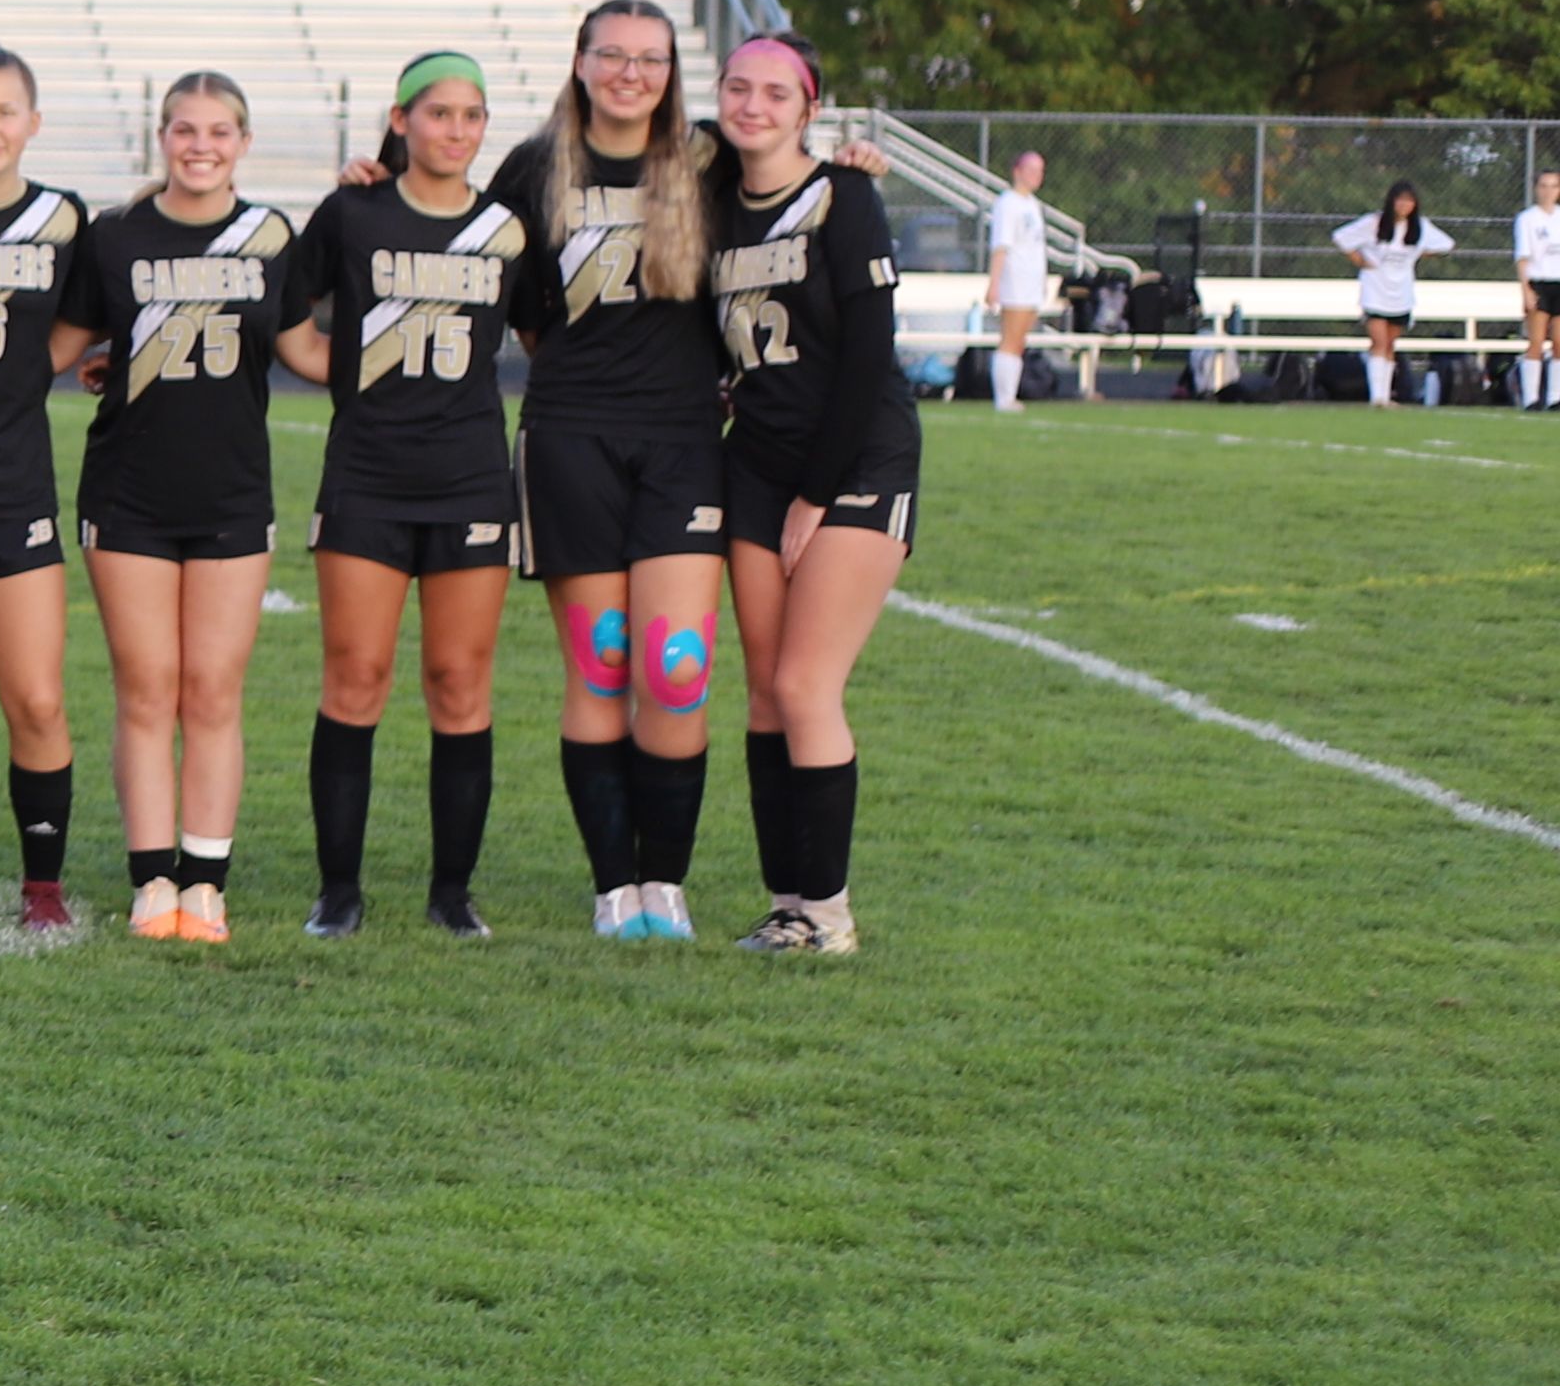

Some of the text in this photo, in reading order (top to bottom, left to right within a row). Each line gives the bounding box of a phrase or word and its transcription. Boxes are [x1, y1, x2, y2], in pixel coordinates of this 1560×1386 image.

[131, 256, 266, 305] CANNERS
[371, 248, 503, 307] CANNERS
[159, 313, 242, 380] 25
[397, 313, 473, 381] 15
[727, 300, 800, 369] 12
